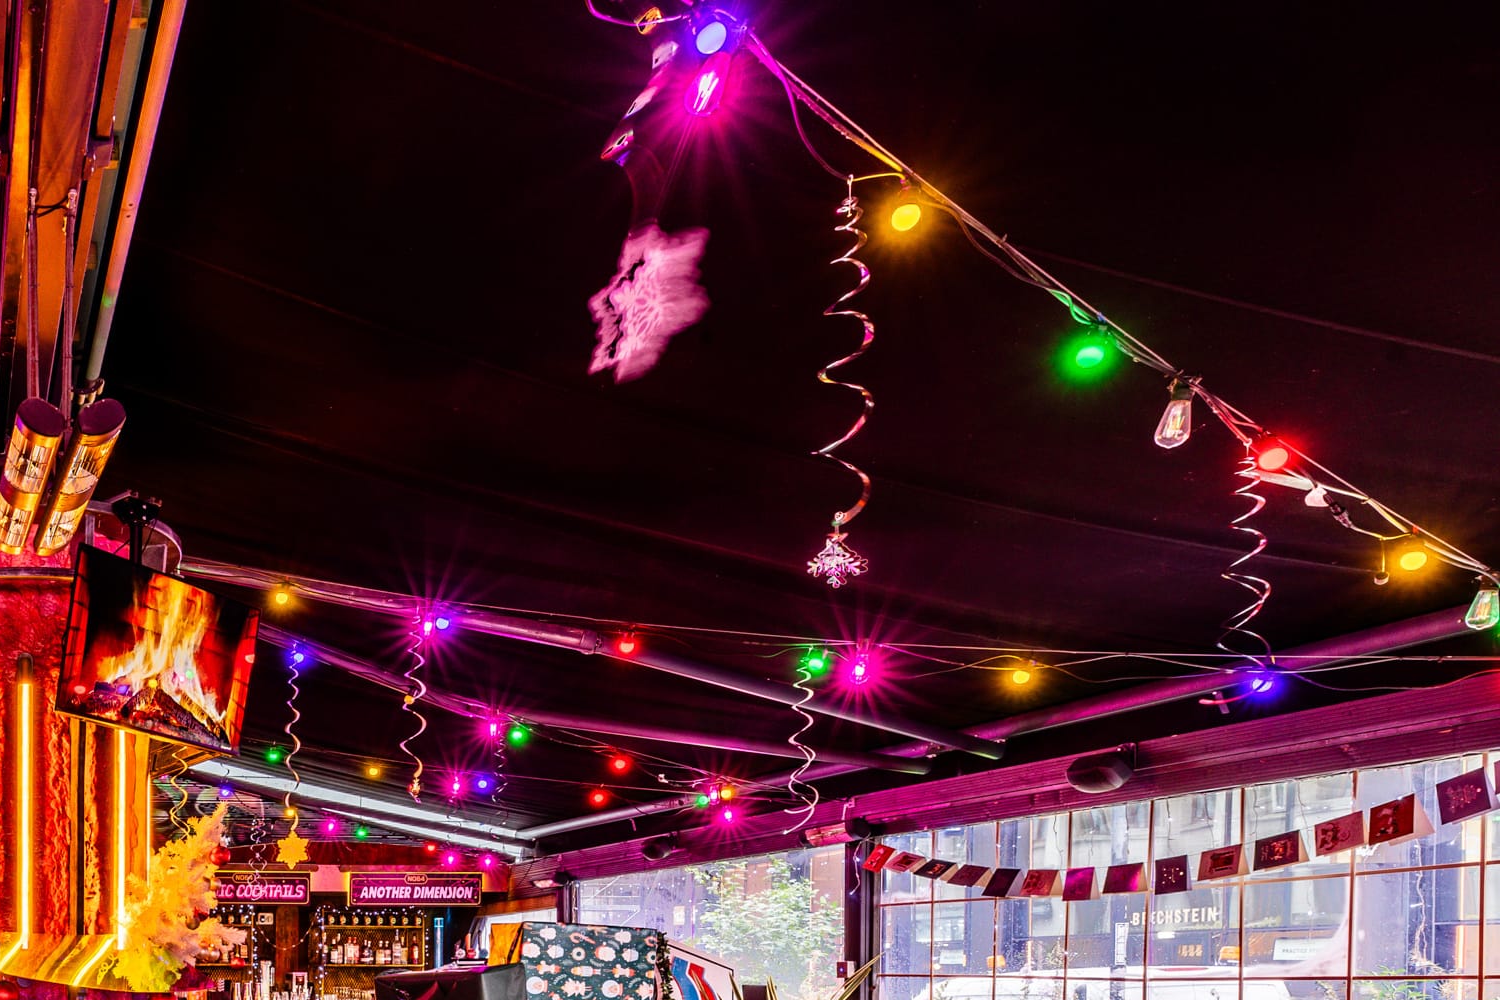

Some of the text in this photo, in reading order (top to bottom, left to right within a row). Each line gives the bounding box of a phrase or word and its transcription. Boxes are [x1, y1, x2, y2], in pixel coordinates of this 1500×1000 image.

[236, 884, 305, 899] COCKTAILS
[360, 885, 473, 899] ANOTHER DIMENSION
